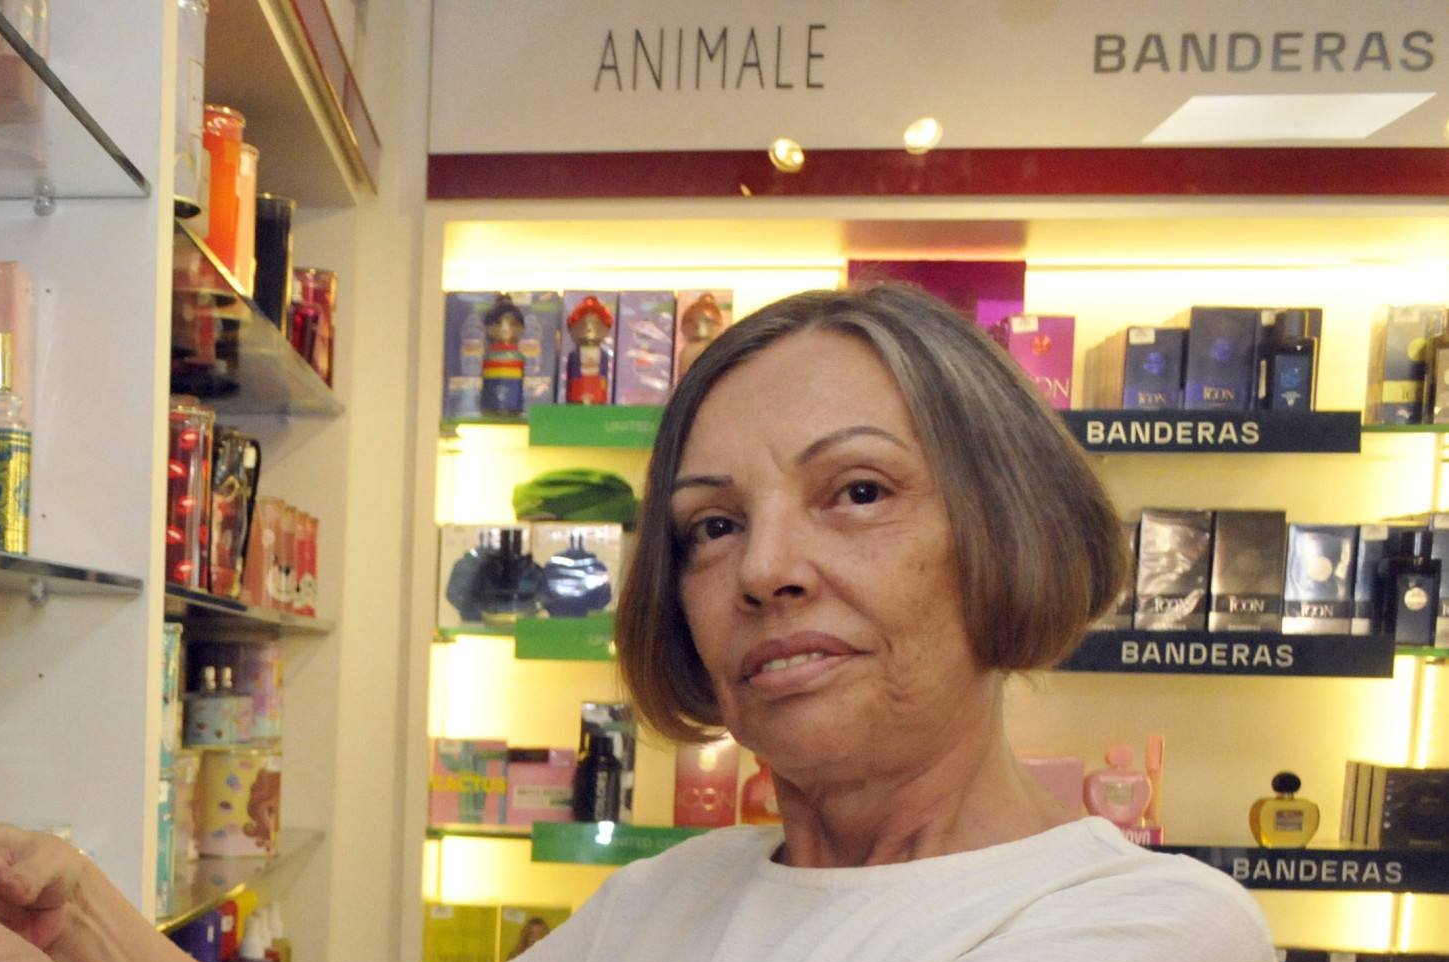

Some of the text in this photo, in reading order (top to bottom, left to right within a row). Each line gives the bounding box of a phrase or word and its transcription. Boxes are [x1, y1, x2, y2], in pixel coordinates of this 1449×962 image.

[594, 24, 827, 92] ANIMALE
[1093, 30, 1435, 74] BANDERAS
[1086, 420, 1260, 445] BANDERAS
[1229, 596, 1265, 613] ICON
[1300, 603, 1334, 618] ICON
[1121, 640, 1294, 668] BANDERAS
[1232, 857, 1403, 884] BANDERAS
